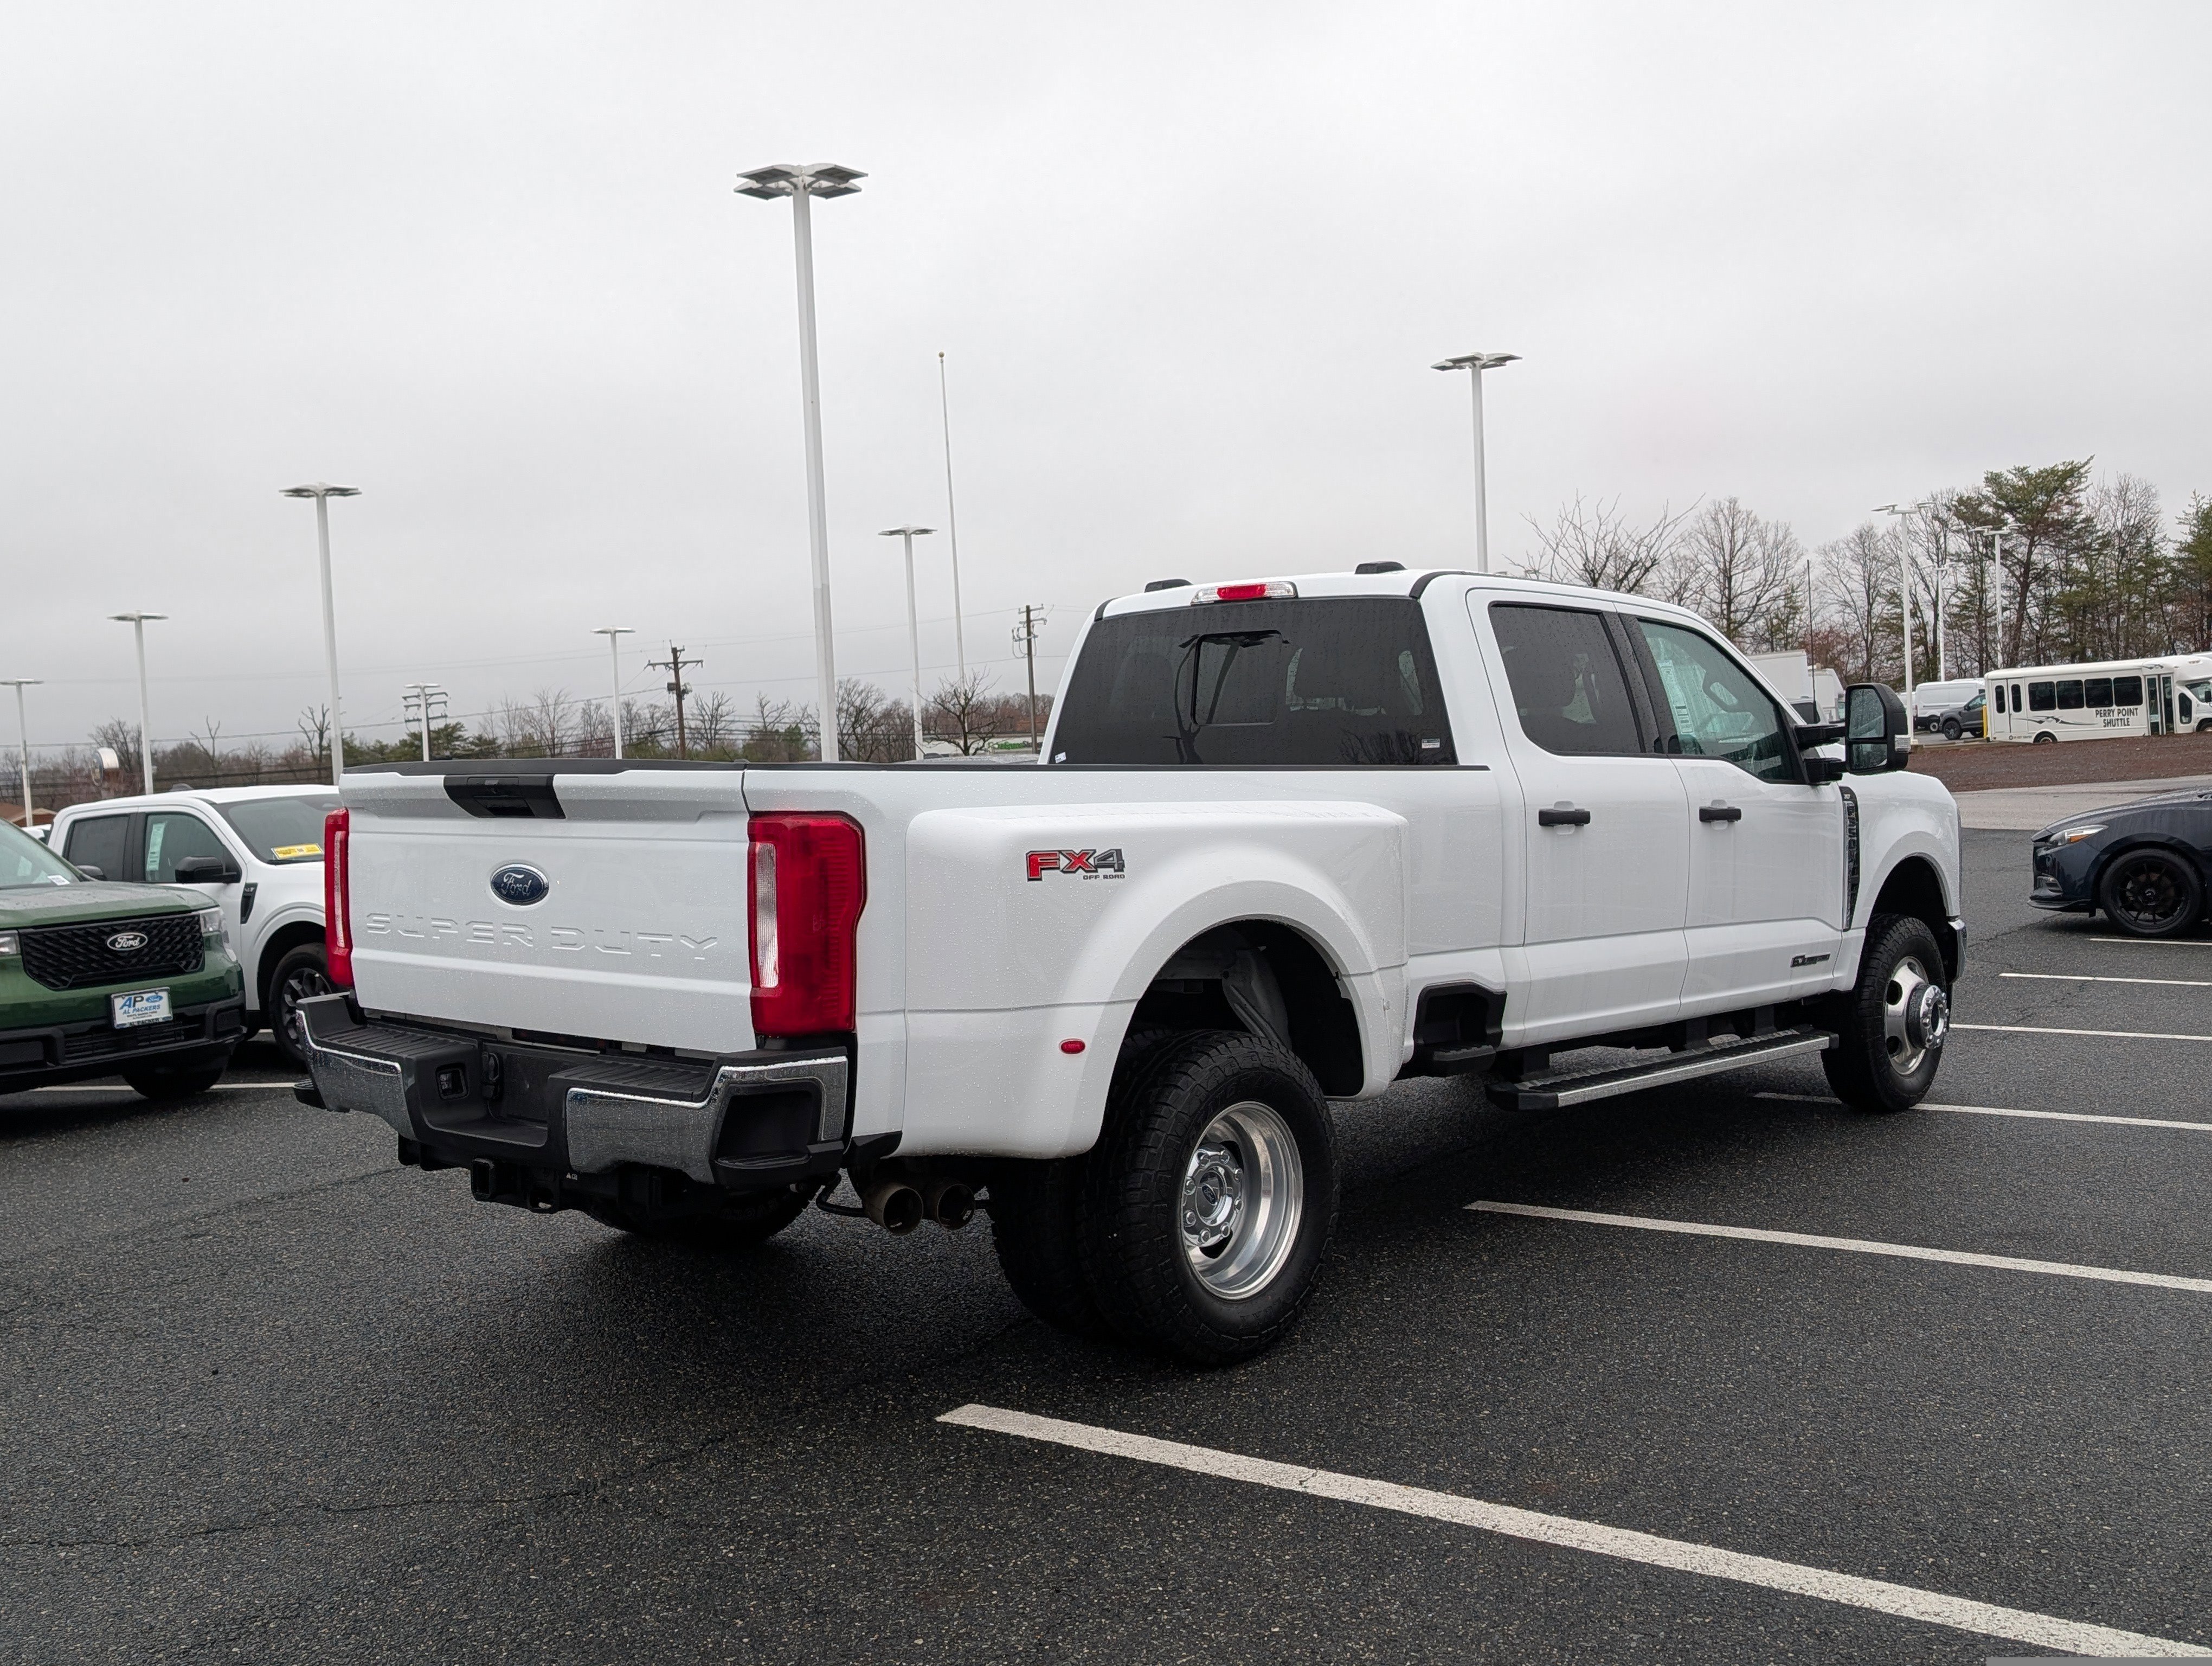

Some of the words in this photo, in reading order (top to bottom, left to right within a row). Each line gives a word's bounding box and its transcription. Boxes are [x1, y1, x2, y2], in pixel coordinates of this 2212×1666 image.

[2095, 708, 2115, 717] PERRY
[2117, 708, 2138, 716] POINT
[2103, 717, 2130, 727] SHUTTLE
[1026, 849, 1126, 882] FX4
[501, 872, 532, 896] Ford
[115, 935, 140, 948] Ford
[366, 913, 534, 947] SUPER
[551, 926, 717, 960] DUTY
[132, 1004, 161, 1013] PACKERS
[1204, 1188, 1214, 1201] Ford
